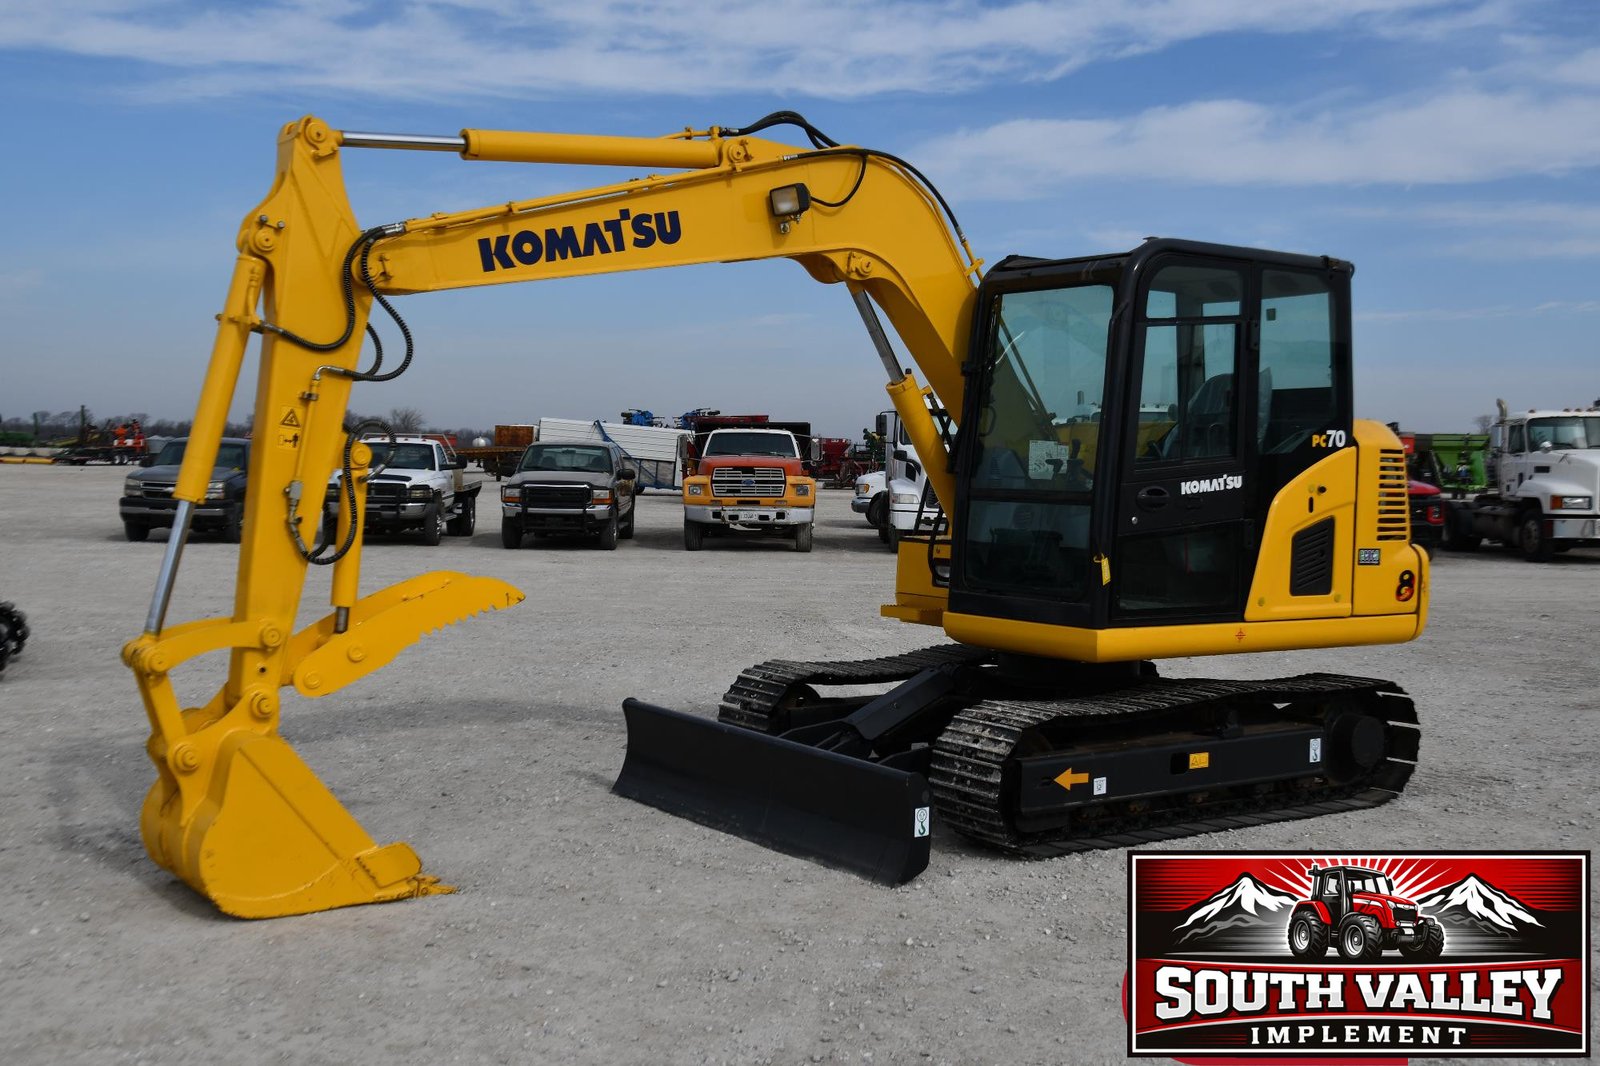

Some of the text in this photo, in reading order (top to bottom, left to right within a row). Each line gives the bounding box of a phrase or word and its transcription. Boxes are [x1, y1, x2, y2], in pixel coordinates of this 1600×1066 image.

[477, 208, 682, 272] KOMATSU
[1312, 430, 1346, 448] PC70
[1180, 474, 1243, 495] KOMATSU
